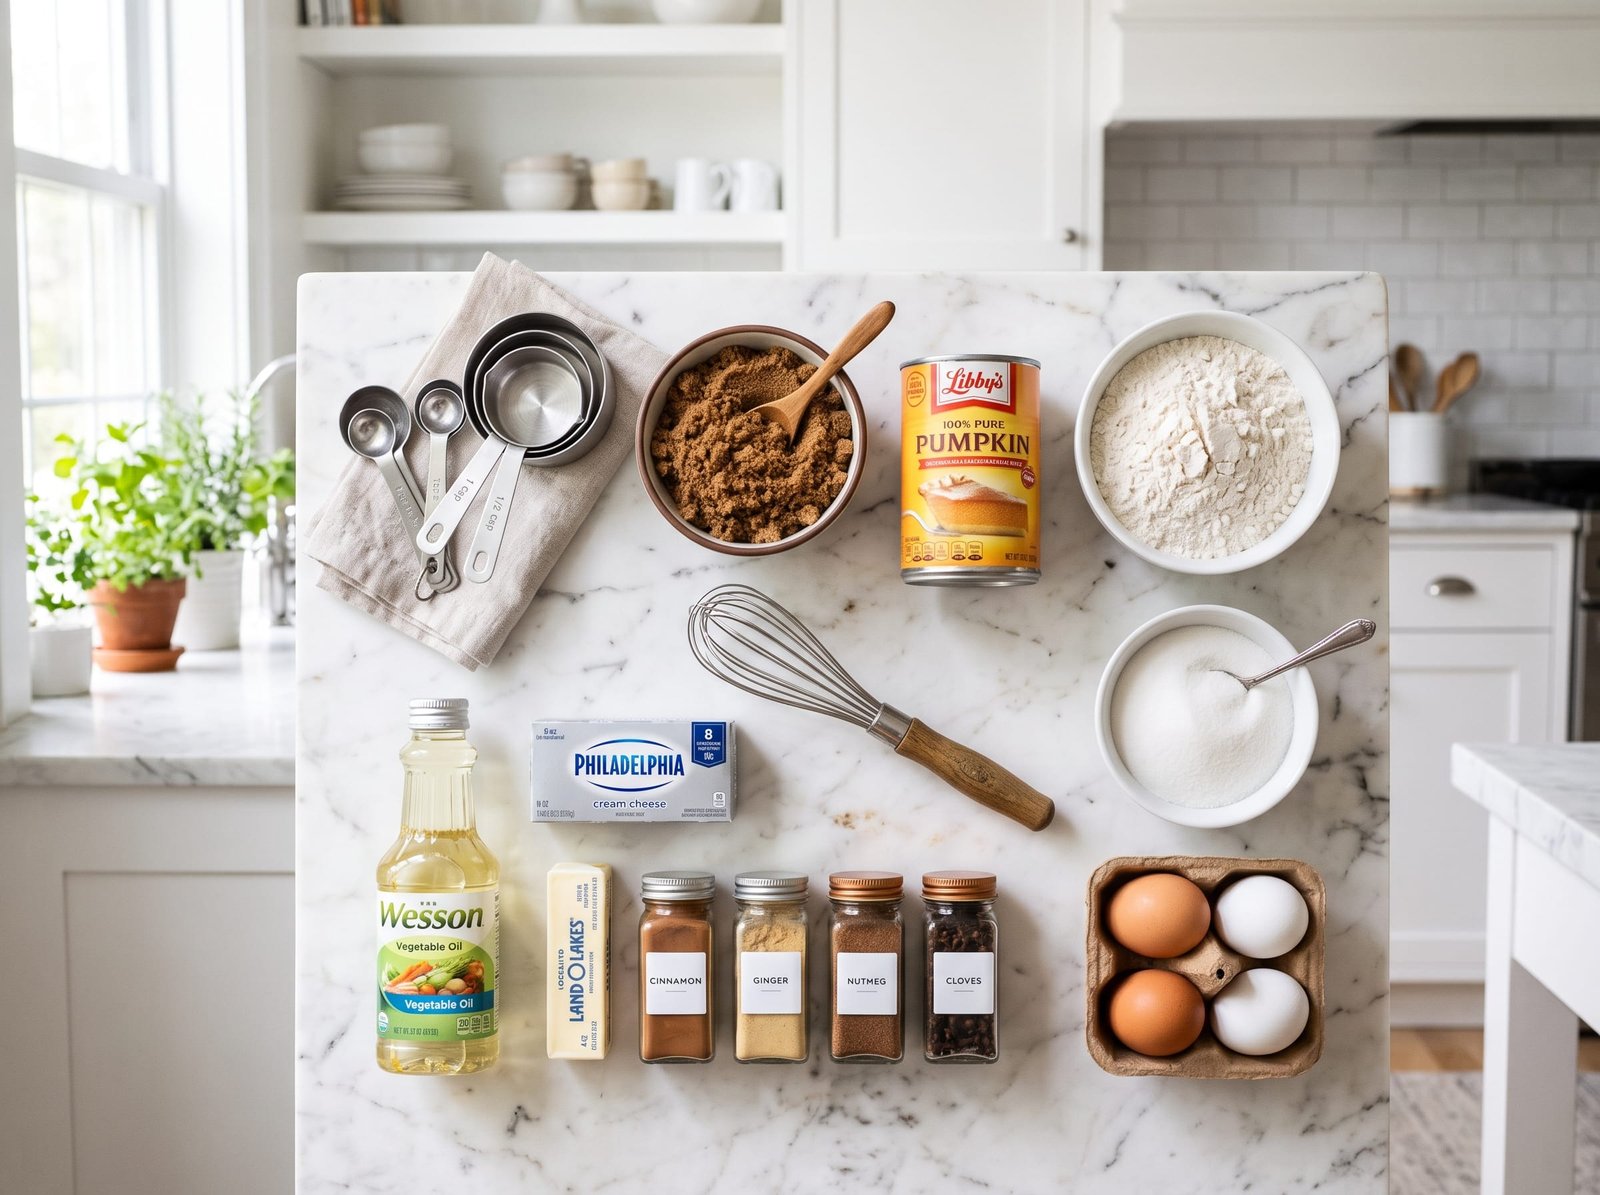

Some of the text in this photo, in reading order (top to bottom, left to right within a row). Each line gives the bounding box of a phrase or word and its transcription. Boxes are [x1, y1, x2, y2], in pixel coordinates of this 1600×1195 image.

[941, 367, 1004, 395] Libby's
[943, 420, 1005, 429] 100% PURE
[916, 432, 1030, 455] PUMPKIN
[704, 728, 713, 740] 8
[574, 753, 685, 777] PHILADELPHIA
[593, 799, 667, 809] cream cheese
[380, 900, 484, 930] Wesson
[569, 919, 585, 961] LAKES
[396, 942, 462, 952] Vegetable Oil
[567, 962, 586, 982] O
[649, 977, 702, 985] CINNAMON
[753, 977, 789, 985] GINGER
[847, 977, 887, 986] NUTMEG
[945, 977, 982, 985] CLOVES
[404, 998, 474, 1010] Vegetable Oil
[569, 983, 585, 1022] LAND
